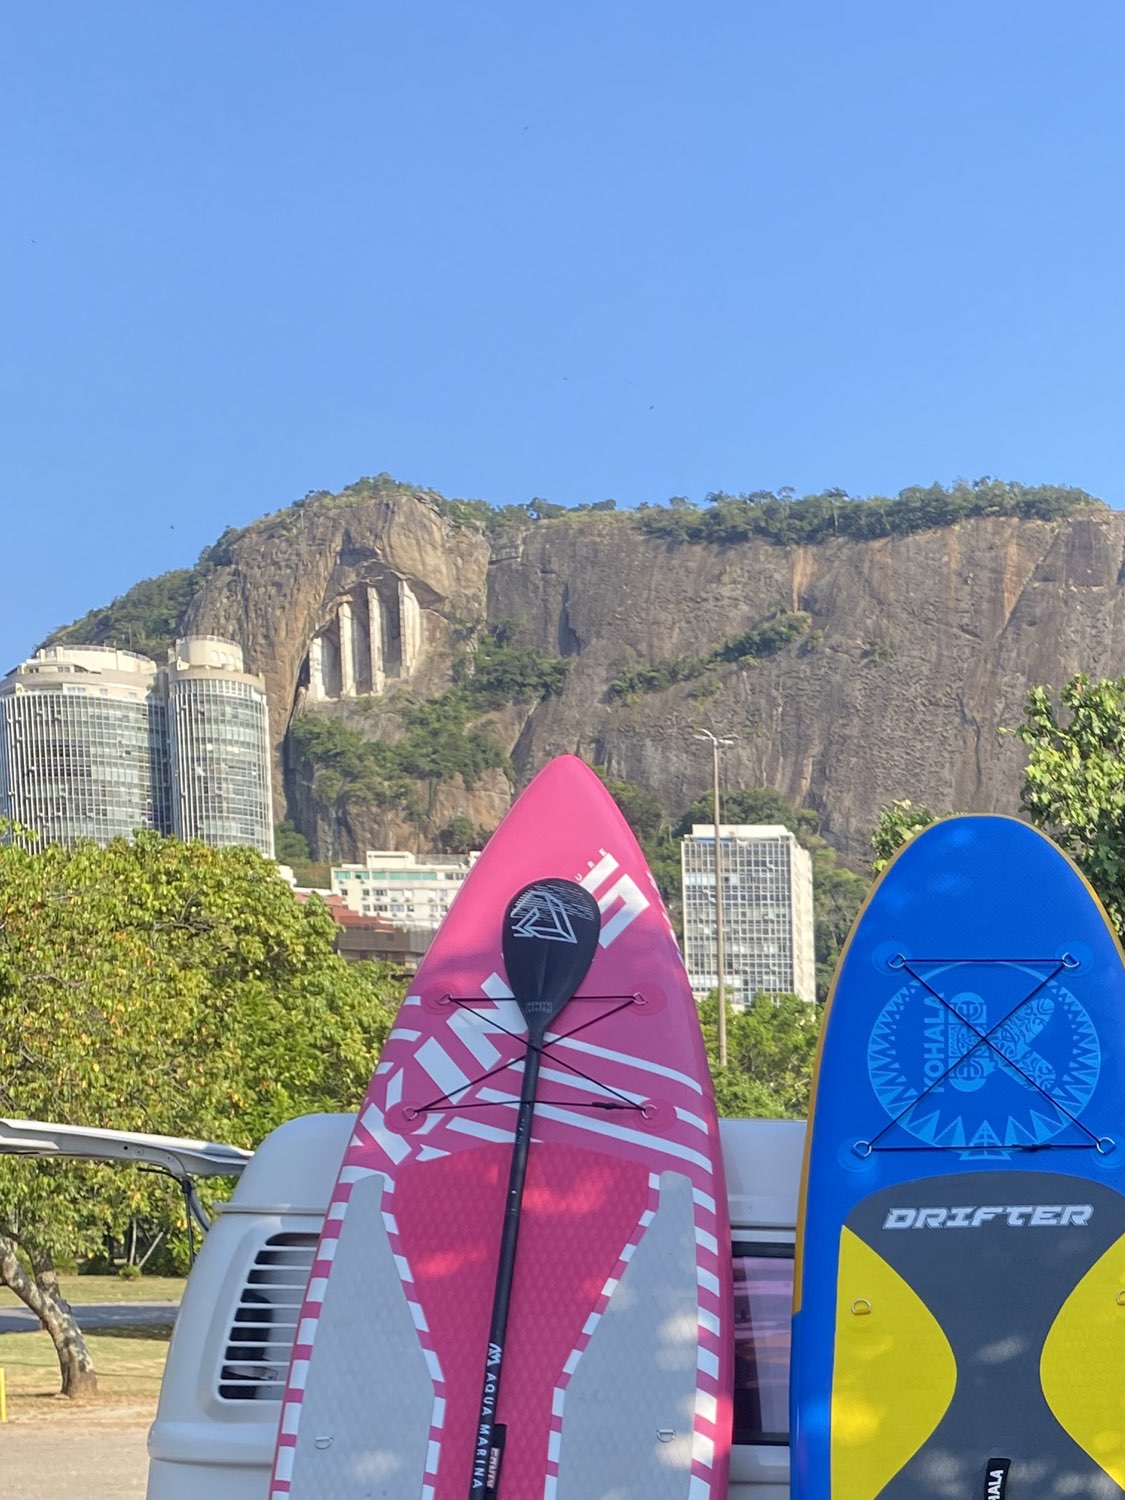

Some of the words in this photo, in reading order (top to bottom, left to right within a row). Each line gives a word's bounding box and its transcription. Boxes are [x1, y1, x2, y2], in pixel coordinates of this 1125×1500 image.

[923, 993, 945, 1093] KOHALA
[882, 1203, 1095, 1231] DRIFTER
[482, 1372, 497, 1417] AQUA
[472, 1422, 491, 1489] MARINA
